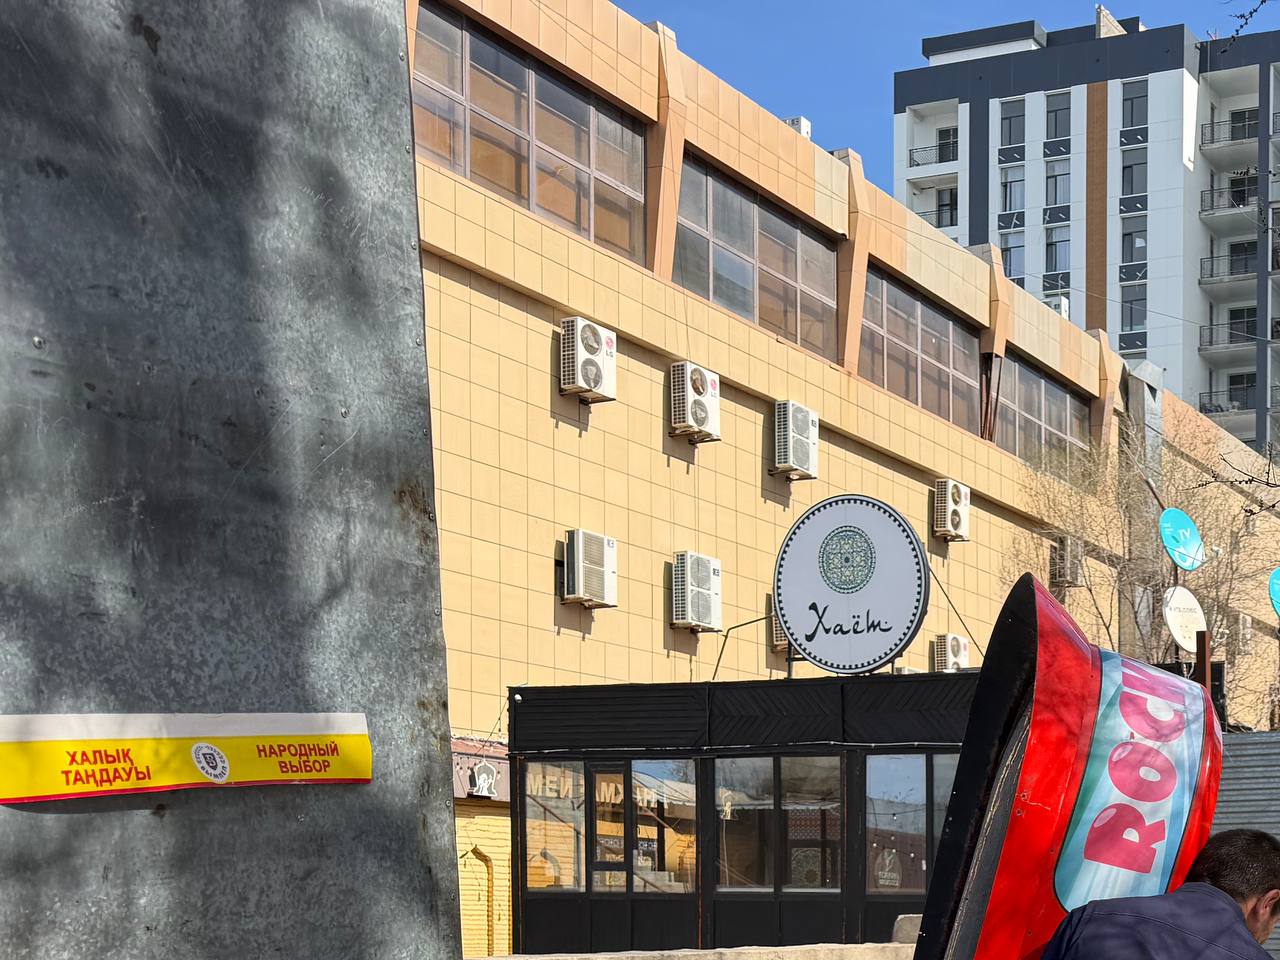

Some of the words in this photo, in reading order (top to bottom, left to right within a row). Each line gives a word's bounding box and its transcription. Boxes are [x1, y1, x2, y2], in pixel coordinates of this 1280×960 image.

[65, 747, 135, 767] ХАЛЫҚ
[256, 740, 340, 760] НАРОДНЫЙ
[61, 765, 152, 788] ТАҢДАУЫ
[278, 759, 331, 774] ВЫБОР
